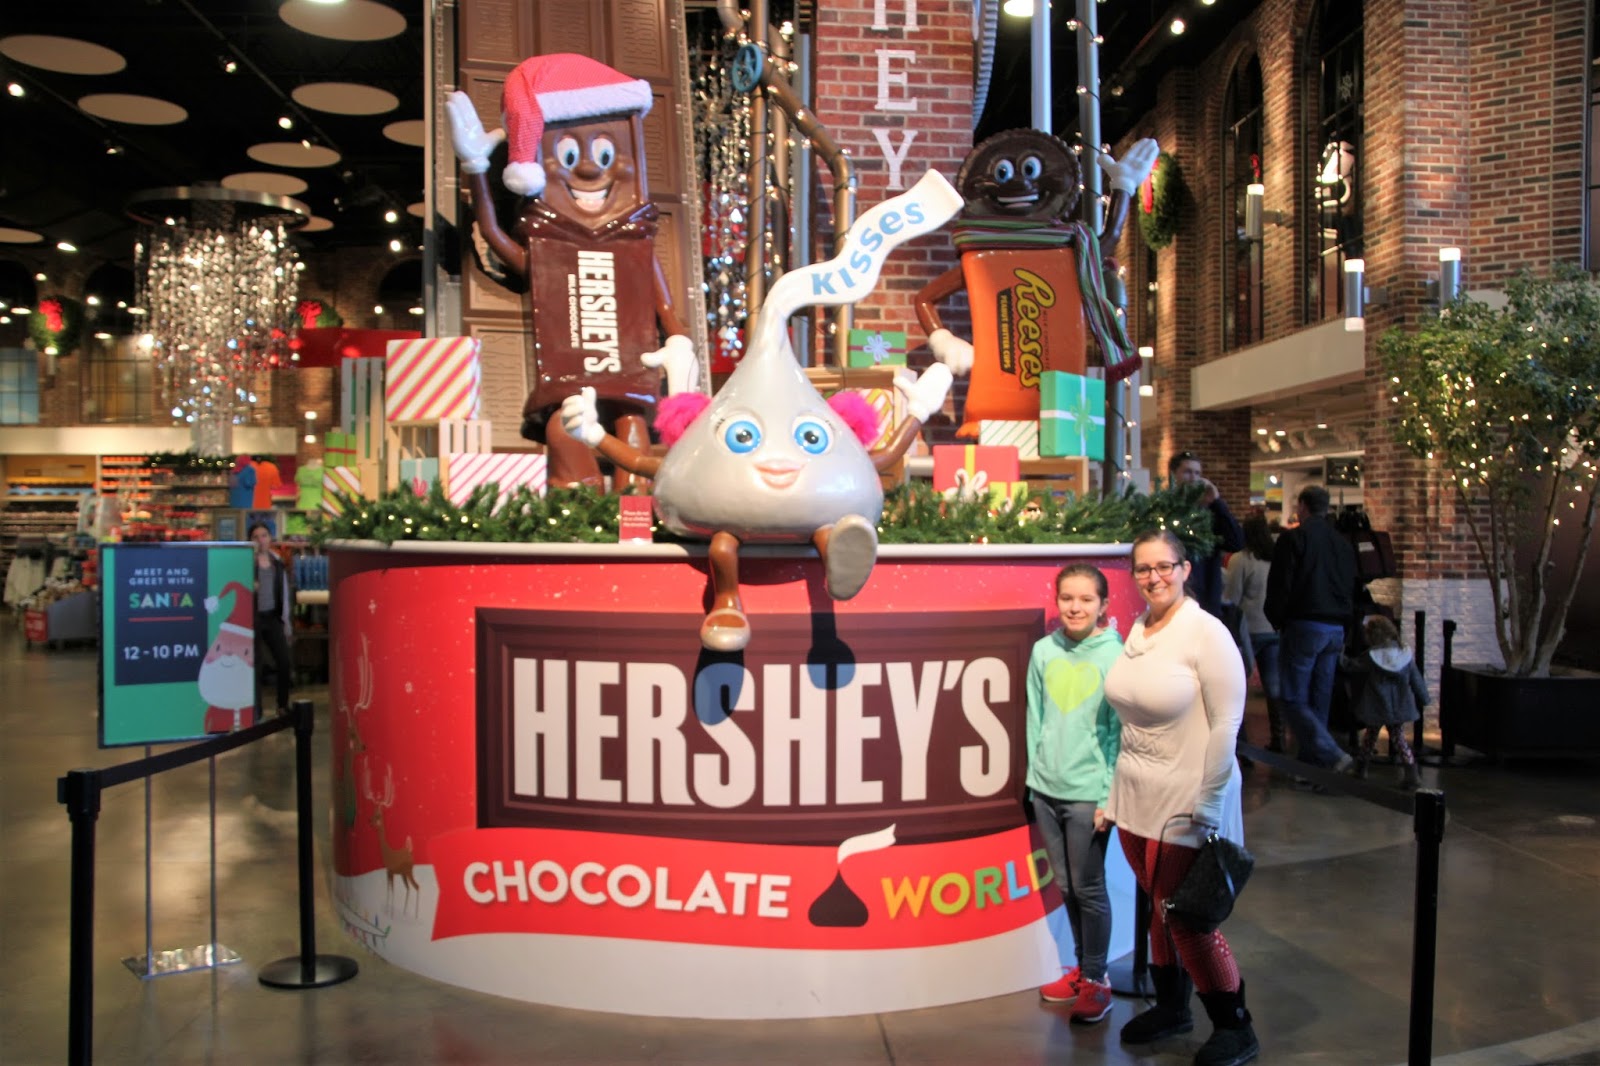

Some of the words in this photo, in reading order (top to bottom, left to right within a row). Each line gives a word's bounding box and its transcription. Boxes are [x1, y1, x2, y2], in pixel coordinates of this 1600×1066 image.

[567, 273, 577, 295] MILK
[577, 250, 621, 373] HERSHEY'S
[1000, 295, 1009, 322] PEANUT
[568, 296, 580, 348] CHOCOLATE
[1013, 268, 1056, 392] Reeses
[1001, 323, 1010, 349] BUTTER
[1003, 350, 1011, 368] CUPS
[129, 577, 163, 586] GREET
[168, 577, 194, 585] WITH
[134, 568, 162, 576] MEET
[166, 568, 189, 576] AND
[129, 592, 194, 609] SANTA
[173, 644, 199, 658] PM
[514, 657, 1010, 808] HERSHEY'S
[463, 859, 792, 918] CHOCOLATE
[881, 848, 1054, 920] WORLD
